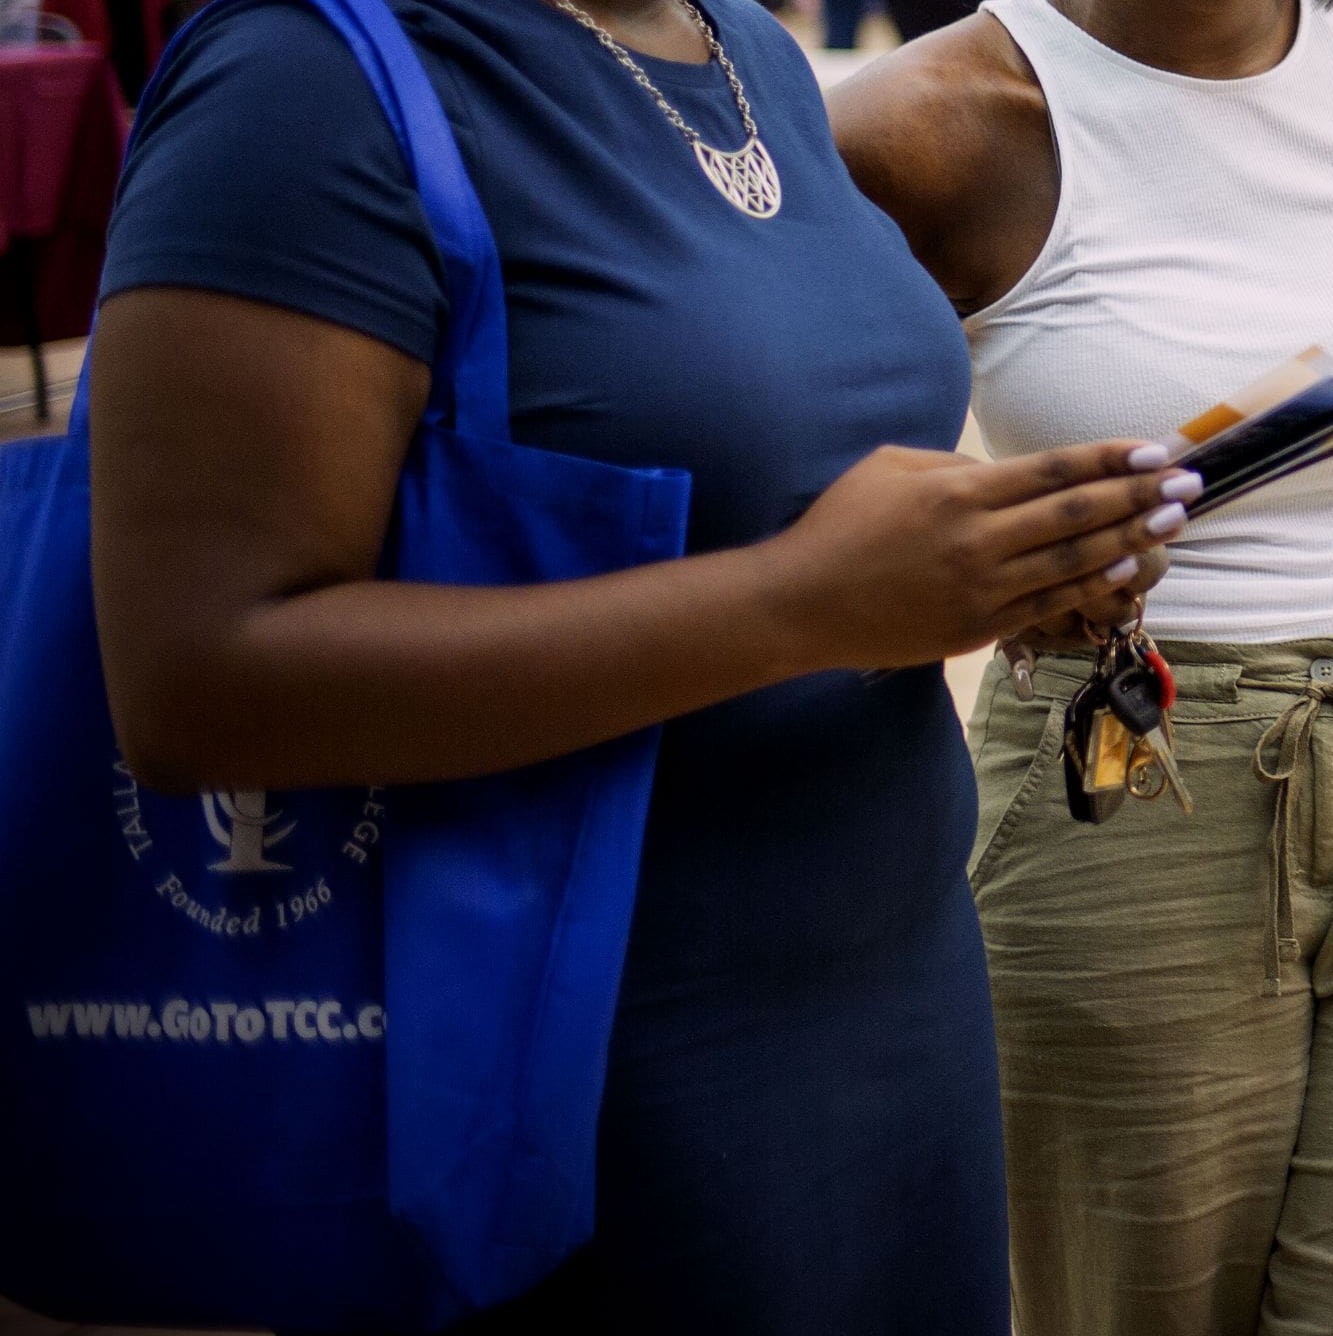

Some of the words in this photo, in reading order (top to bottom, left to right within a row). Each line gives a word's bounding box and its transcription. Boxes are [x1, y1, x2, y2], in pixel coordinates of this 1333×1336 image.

[154, 873, 262, 937] Founded
[275, 876, 333, 930] 1966
[27, 998, 387, 1042] www.GoToTCC.c
